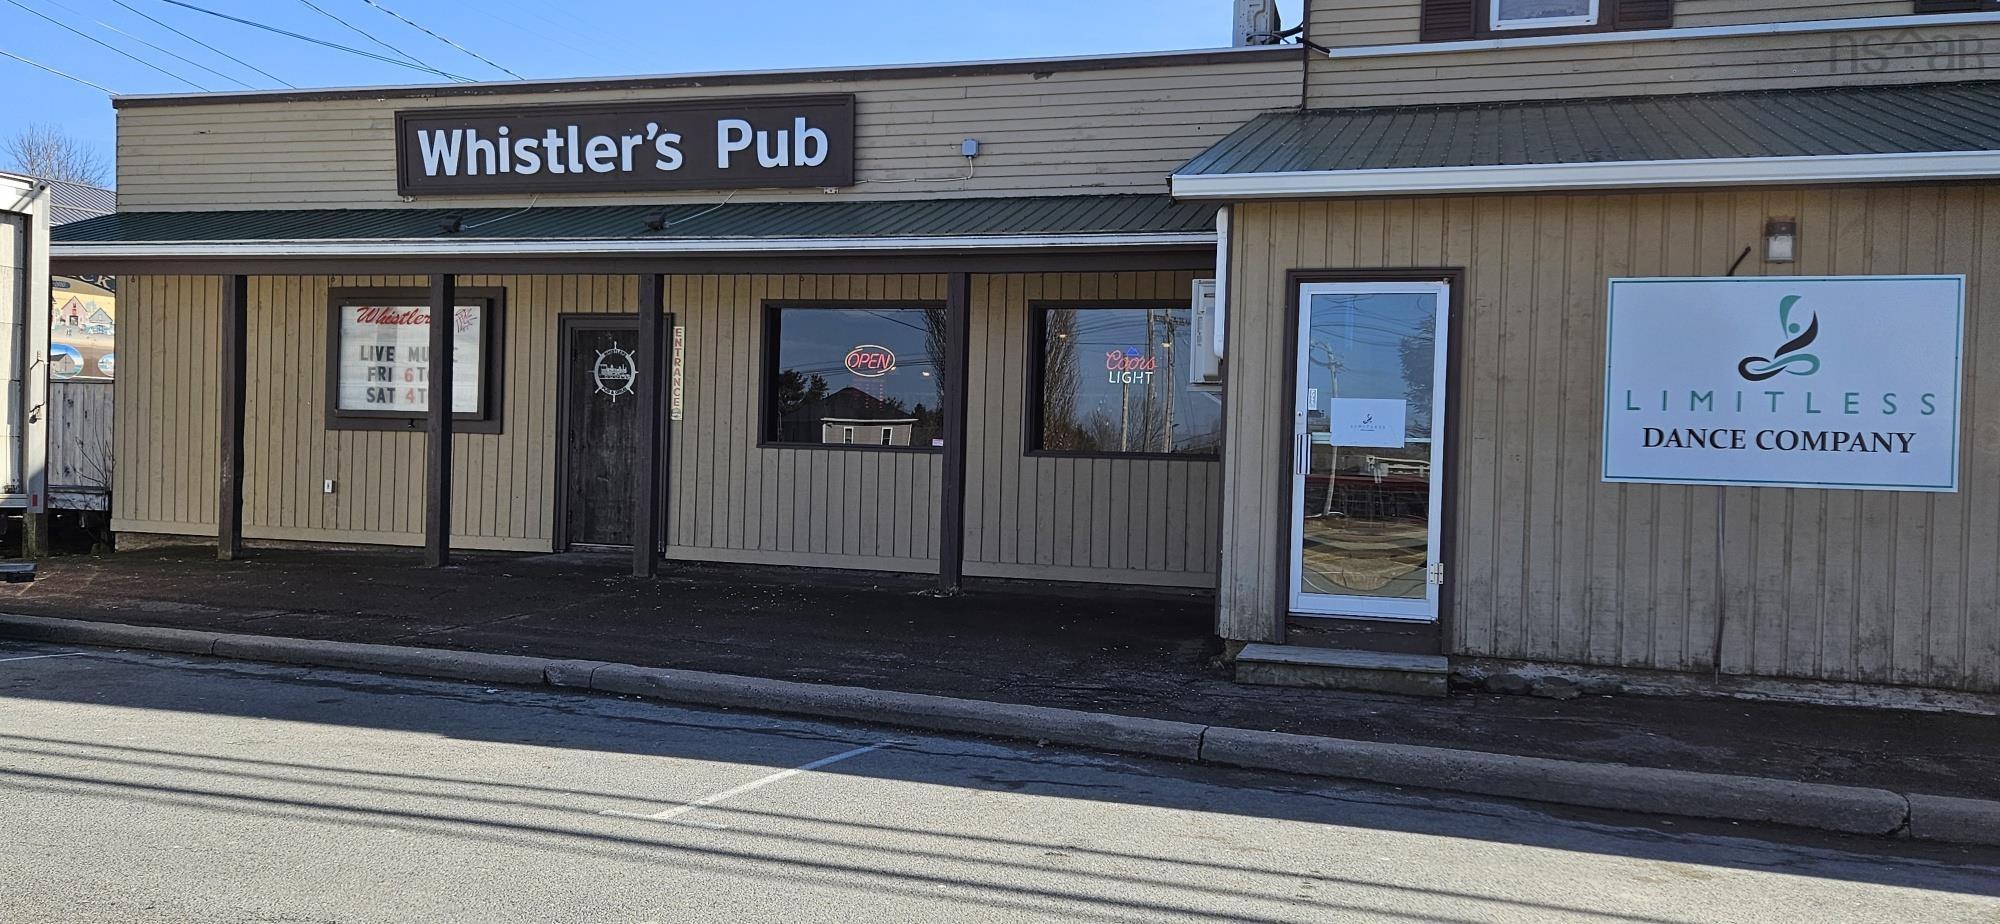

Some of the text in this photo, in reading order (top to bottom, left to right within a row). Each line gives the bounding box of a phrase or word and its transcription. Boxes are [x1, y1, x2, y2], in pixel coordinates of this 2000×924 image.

[417, 117, 829, 177] Whistler's Pub
[356, 306, 431, 325] Whistler
[360, 345, 396, 362] LIVE
[847, 352, 892, 369] OPEN
[1105, 350, 1156, 370] Coors
[367, 366, 393, 383] FRI
[673, 328, 683, 407] ENTRANCE
[1108, 371, 1153, 385] LIGHT
[366, 387, 396, 403] SAT
[1625, 389, 1937, 416] LIMITLESS
[1641, 427, 1917, 454] DANCE COMPANY
